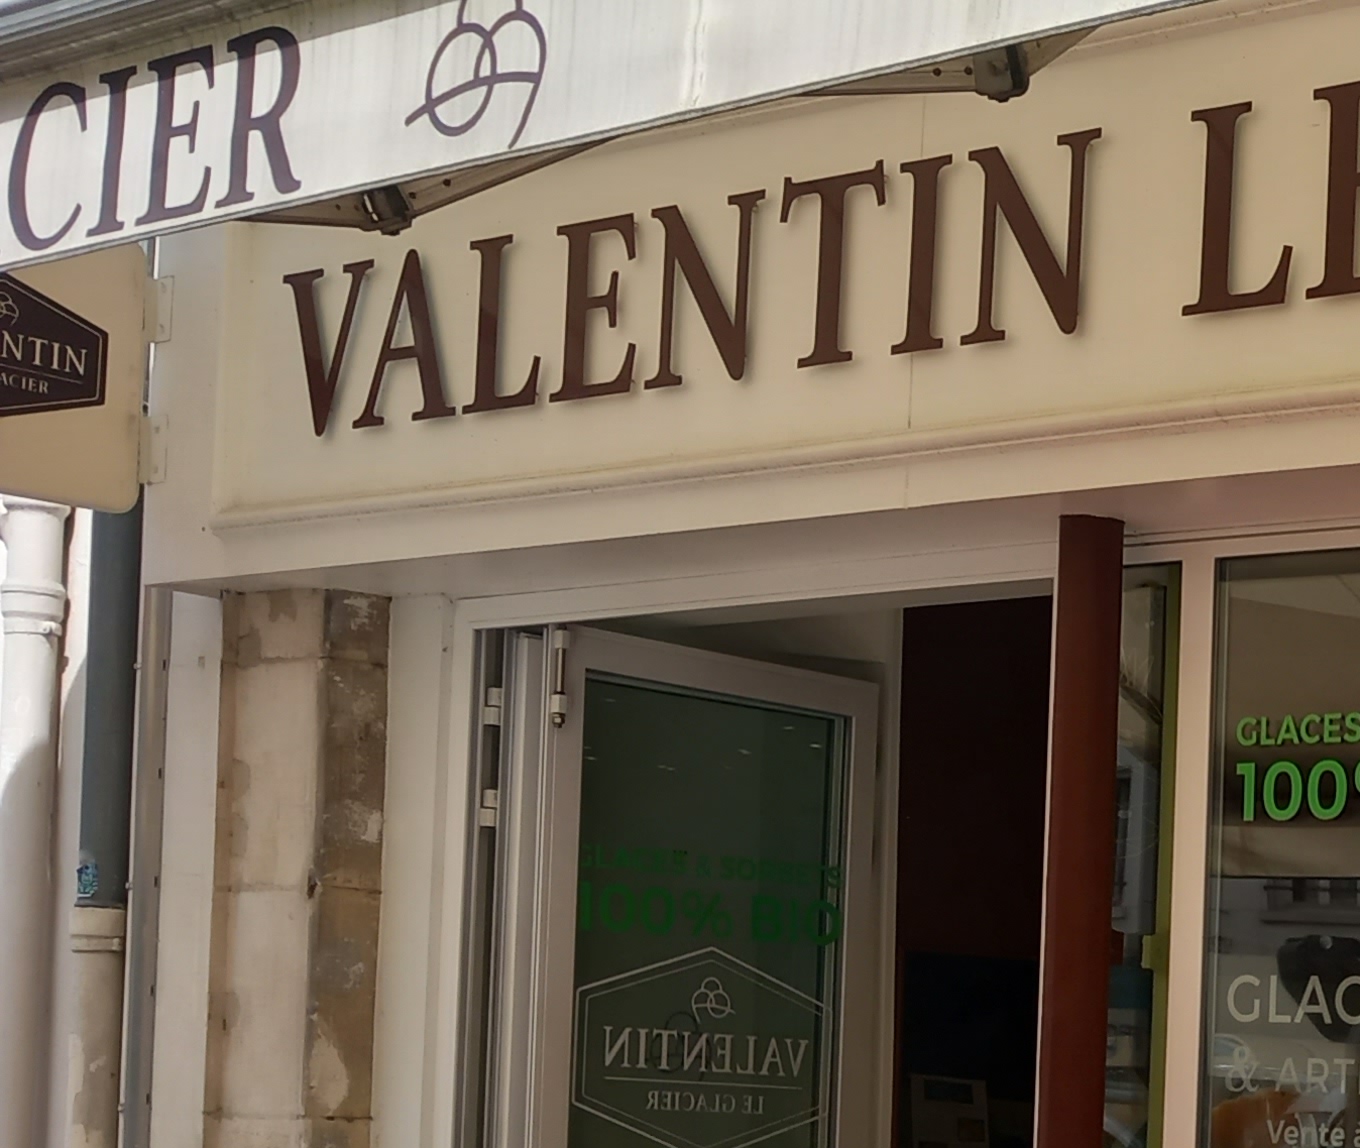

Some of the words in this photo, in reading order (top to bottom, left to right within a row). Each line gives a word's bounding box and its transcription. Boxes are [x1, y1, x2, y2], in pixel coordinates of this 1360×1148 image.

[6, 26, 302, 251] CIER
[283, 128, 1102, 437] VALENTIN
[1224, 1046, 1260, 1093] &
[1267, 1119, 1346, 1148] Vente
